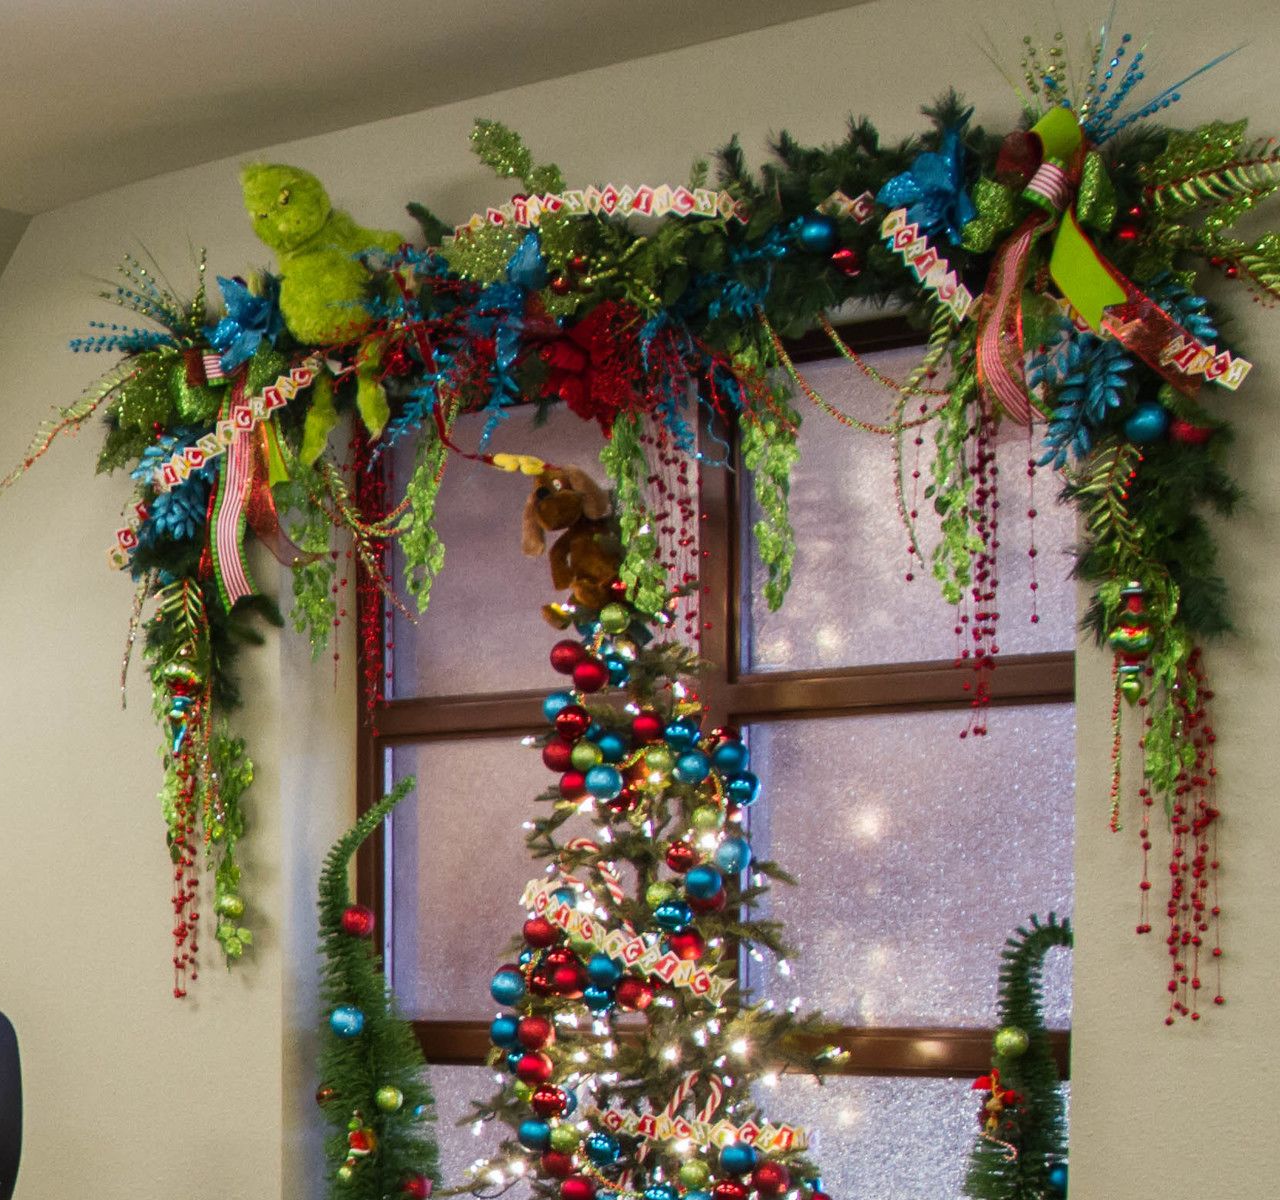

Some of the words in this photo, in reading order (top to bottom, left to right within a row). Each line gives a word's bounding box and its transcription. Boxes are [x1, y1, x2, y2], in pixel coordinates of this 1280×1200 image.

[601, 184, 718, 217] GRINCH
[234, 358, 321, 431] GRINC
[622, 936, 724, 1004] GRINCH
